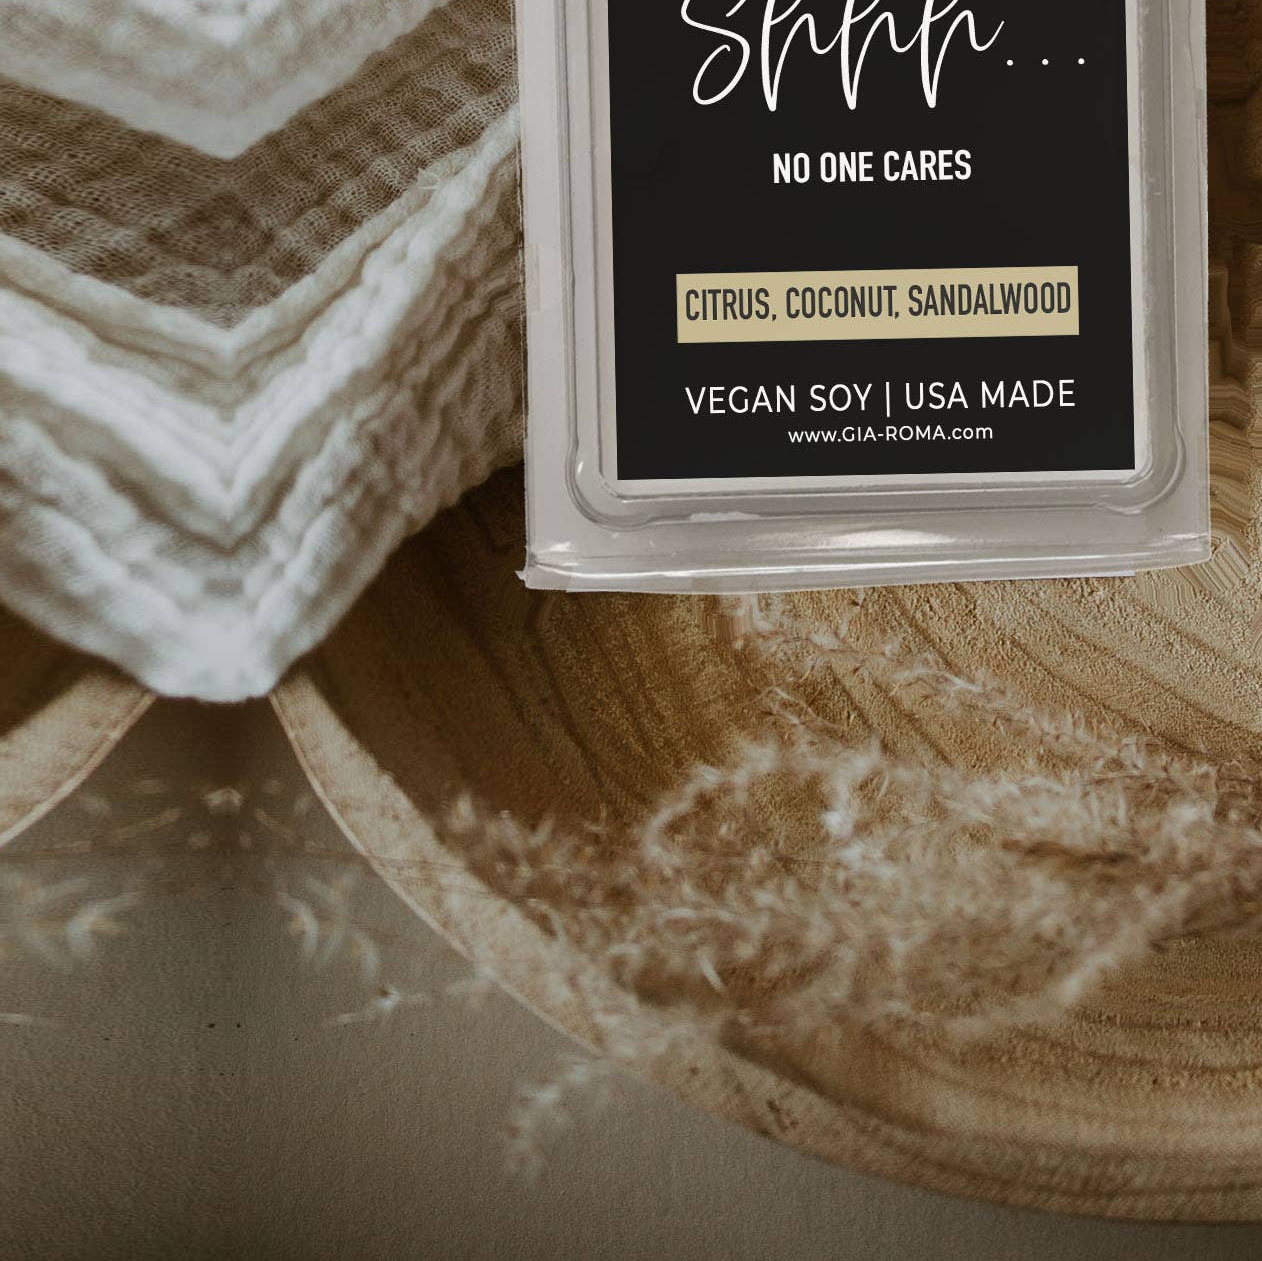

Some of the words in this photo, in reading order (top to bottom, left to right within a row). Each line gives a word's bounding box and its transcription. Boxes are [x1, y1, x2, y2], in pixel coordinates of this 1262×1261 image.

[773, 152, 811, 184] NO
[819, 151, 874, 183] ONE
[883, 149, 972, 182] CARES
[685, 287, 777, 322] CITRUS,
[785, 285, 900, 320] COCONUT,
[908, 281, 1071, 317] SANDALWOOD
[684, 384, 796, 415] VEGAN
[809, 383, 873, 412] SOY
[905, 381, 969, 410] USA
[981, 379, 1076, 409] MADE
[787, 424, 993, 443] www.GIA-ROMA.com
